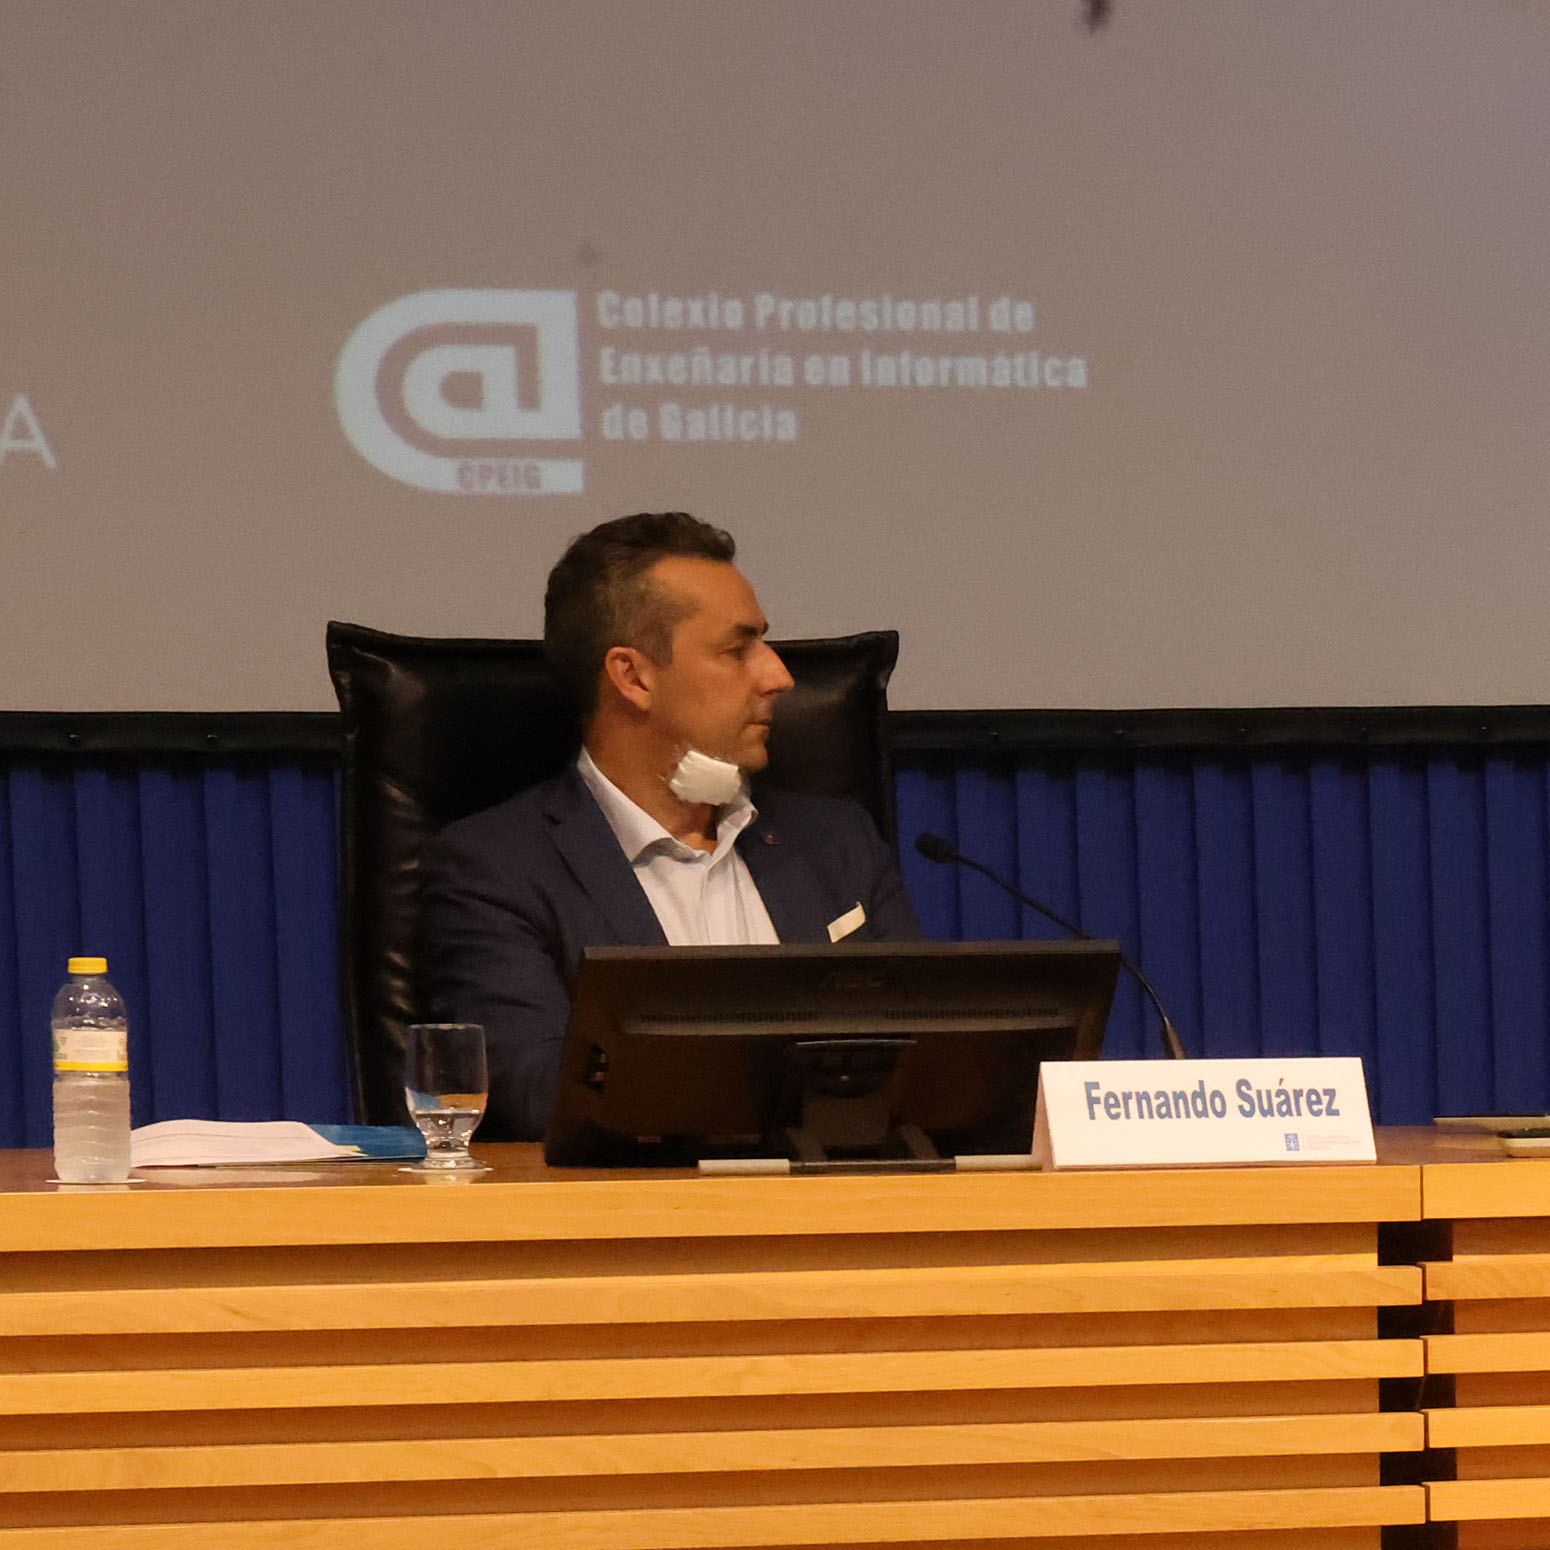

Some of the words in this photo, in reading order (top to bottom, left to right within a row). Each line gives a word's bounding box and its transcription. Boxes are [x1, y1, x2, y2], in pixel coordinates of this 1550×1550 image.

[598, 290, 745, 329] Colexio
[755, 292, 981, 331] Profesional
[989, 296, 1035, 331] de
[804, 355, 850, 387] en
[603, 402, 648, 440] de
[659, 402, 797, 440] Galicia
[1084, 1080, 1227, 1121] Fernando
[1235, 1078, 1340, 1118] Suárez
